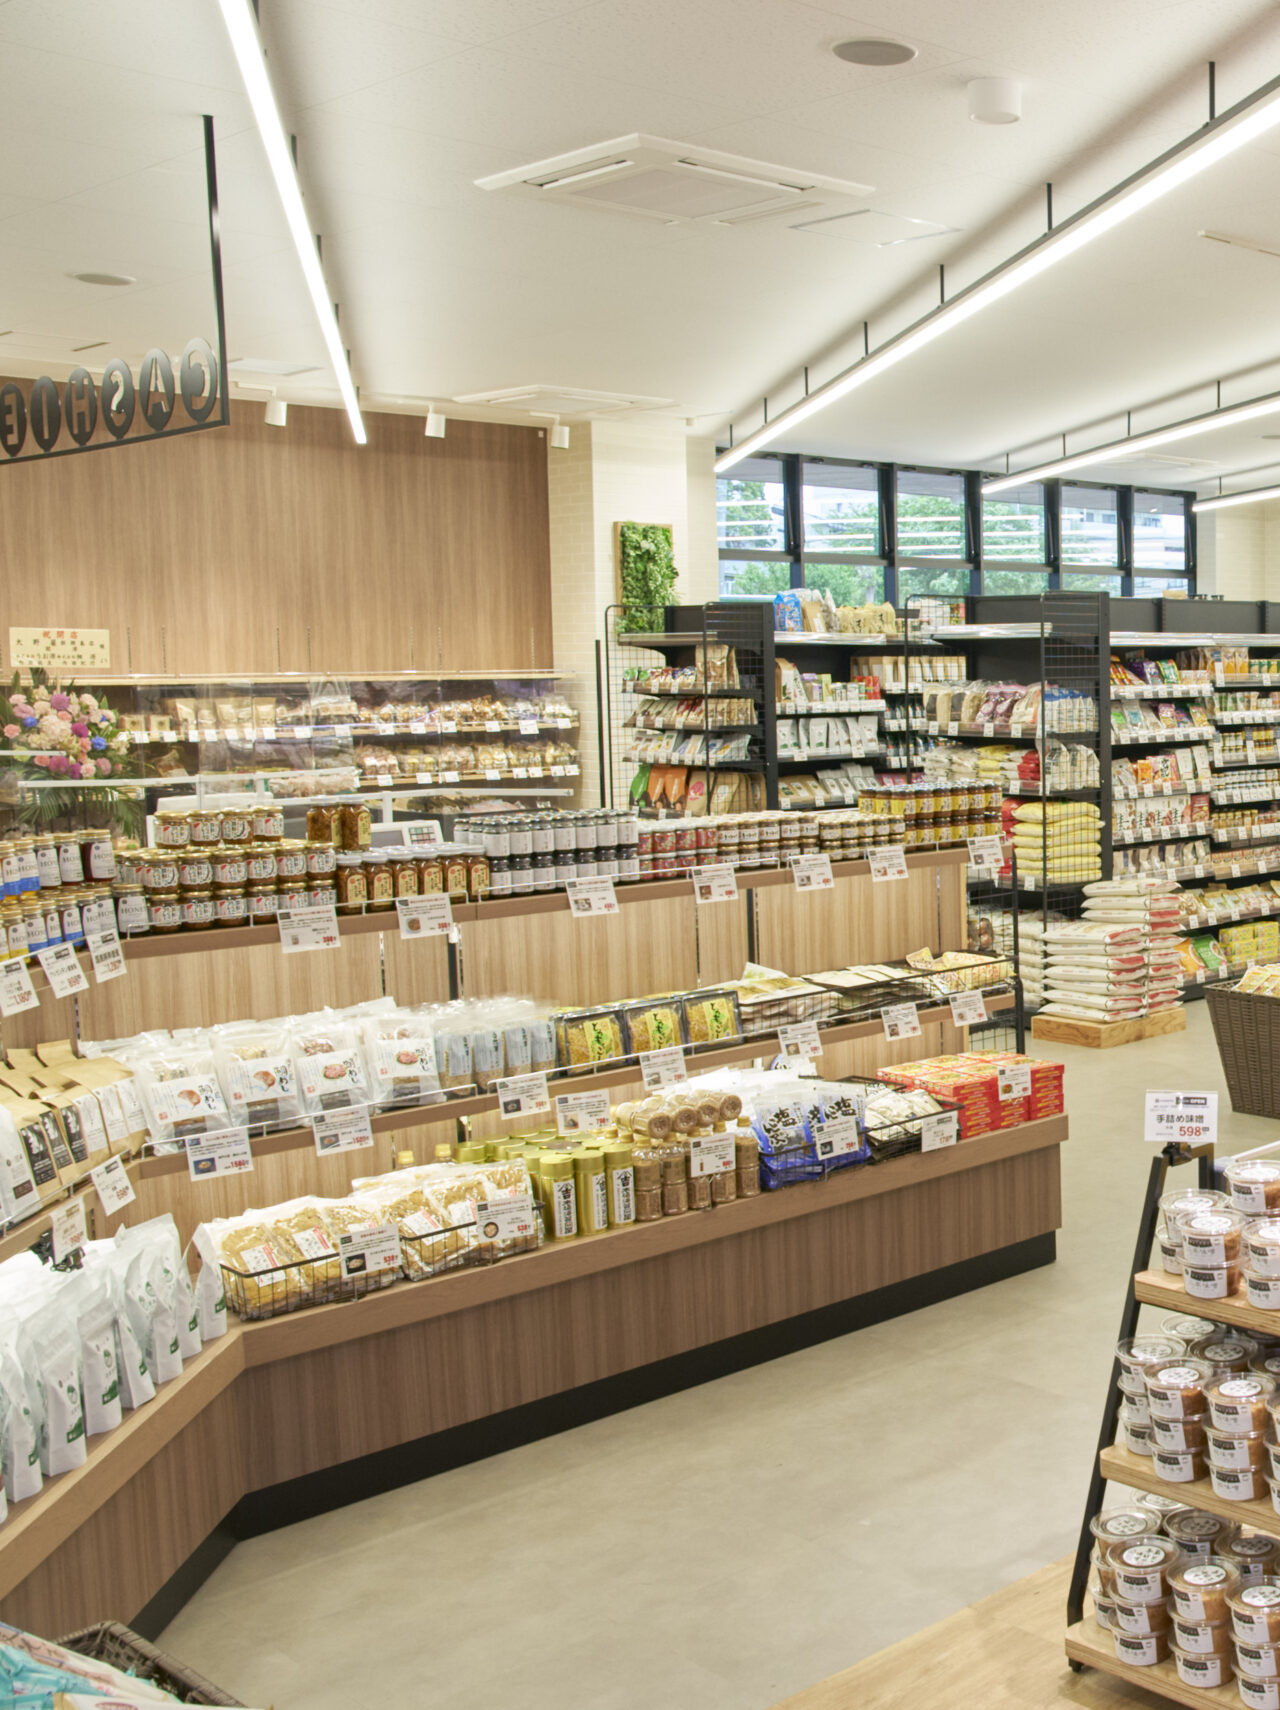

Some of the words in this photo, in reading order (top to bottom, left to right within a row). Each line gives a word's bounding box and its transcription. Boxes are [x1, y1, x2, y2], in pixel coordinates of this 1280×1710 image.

[1156, 1114, 1204, 1123] 手詰め味噌
[1179, 1126, 1202, 1136] 598
